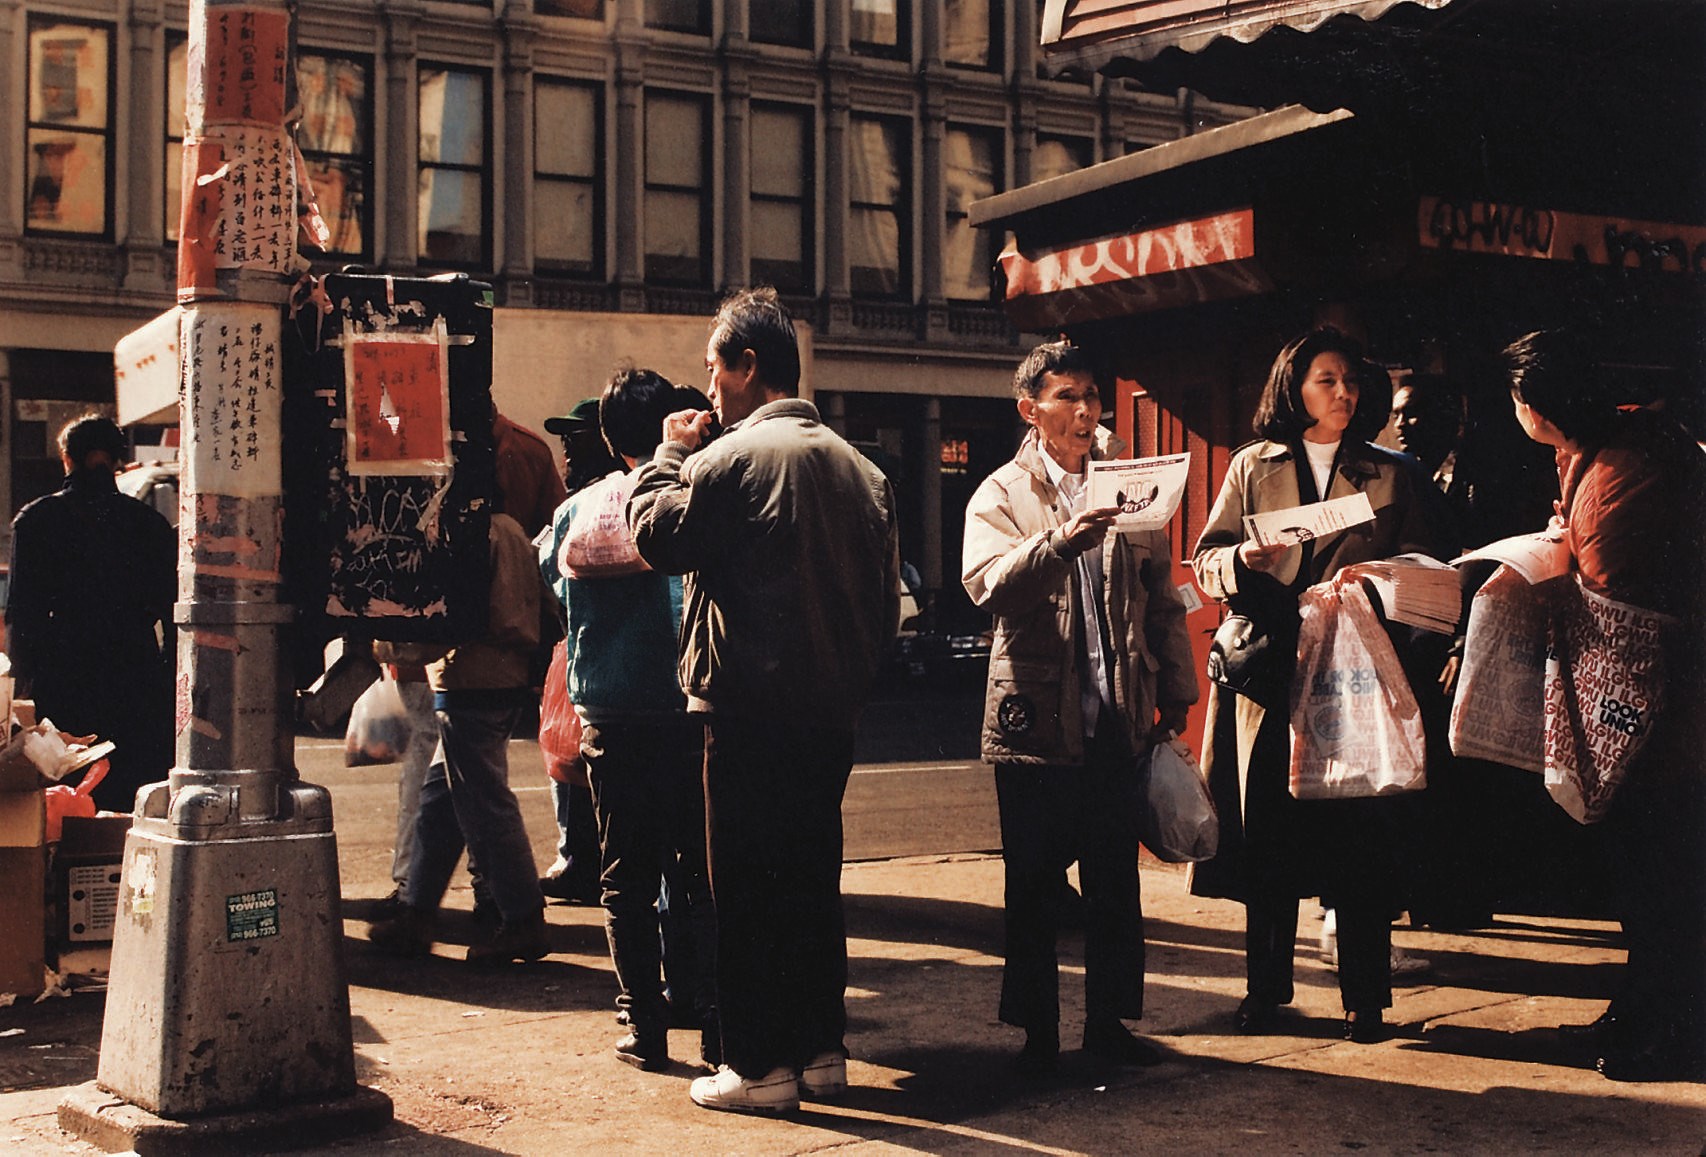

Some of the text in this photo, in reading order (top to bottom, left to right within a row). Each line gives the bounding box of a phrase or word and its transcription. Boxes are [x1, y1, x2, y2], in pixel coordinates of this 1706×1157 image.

[1600, 694, 1644, 724] LOOK
[1585, 716, 1632, 750] ILGWU
[228, 898, 276, 913] TOWING
